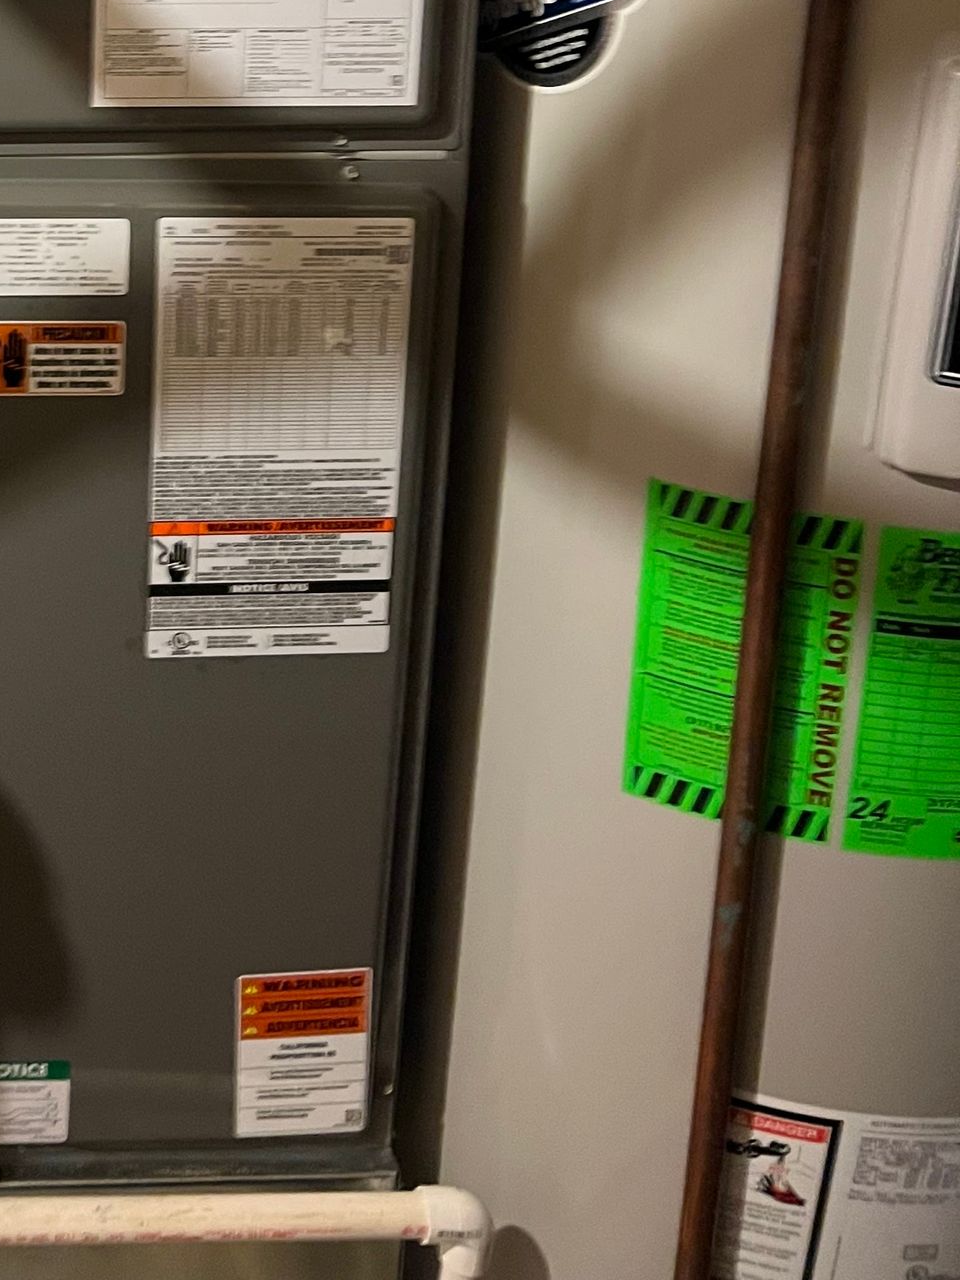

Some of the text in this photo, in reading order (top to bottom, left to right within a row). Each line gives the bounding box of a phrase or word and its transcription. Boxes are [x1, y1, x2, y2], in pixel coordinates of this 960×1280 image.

[806, 557, 858, 808] DO NOT REMOVE
[847, 796, 891, 821] 24
[262, 975, 365, 992] WARNING
[753, 1116, 819, 1139] DANGER
